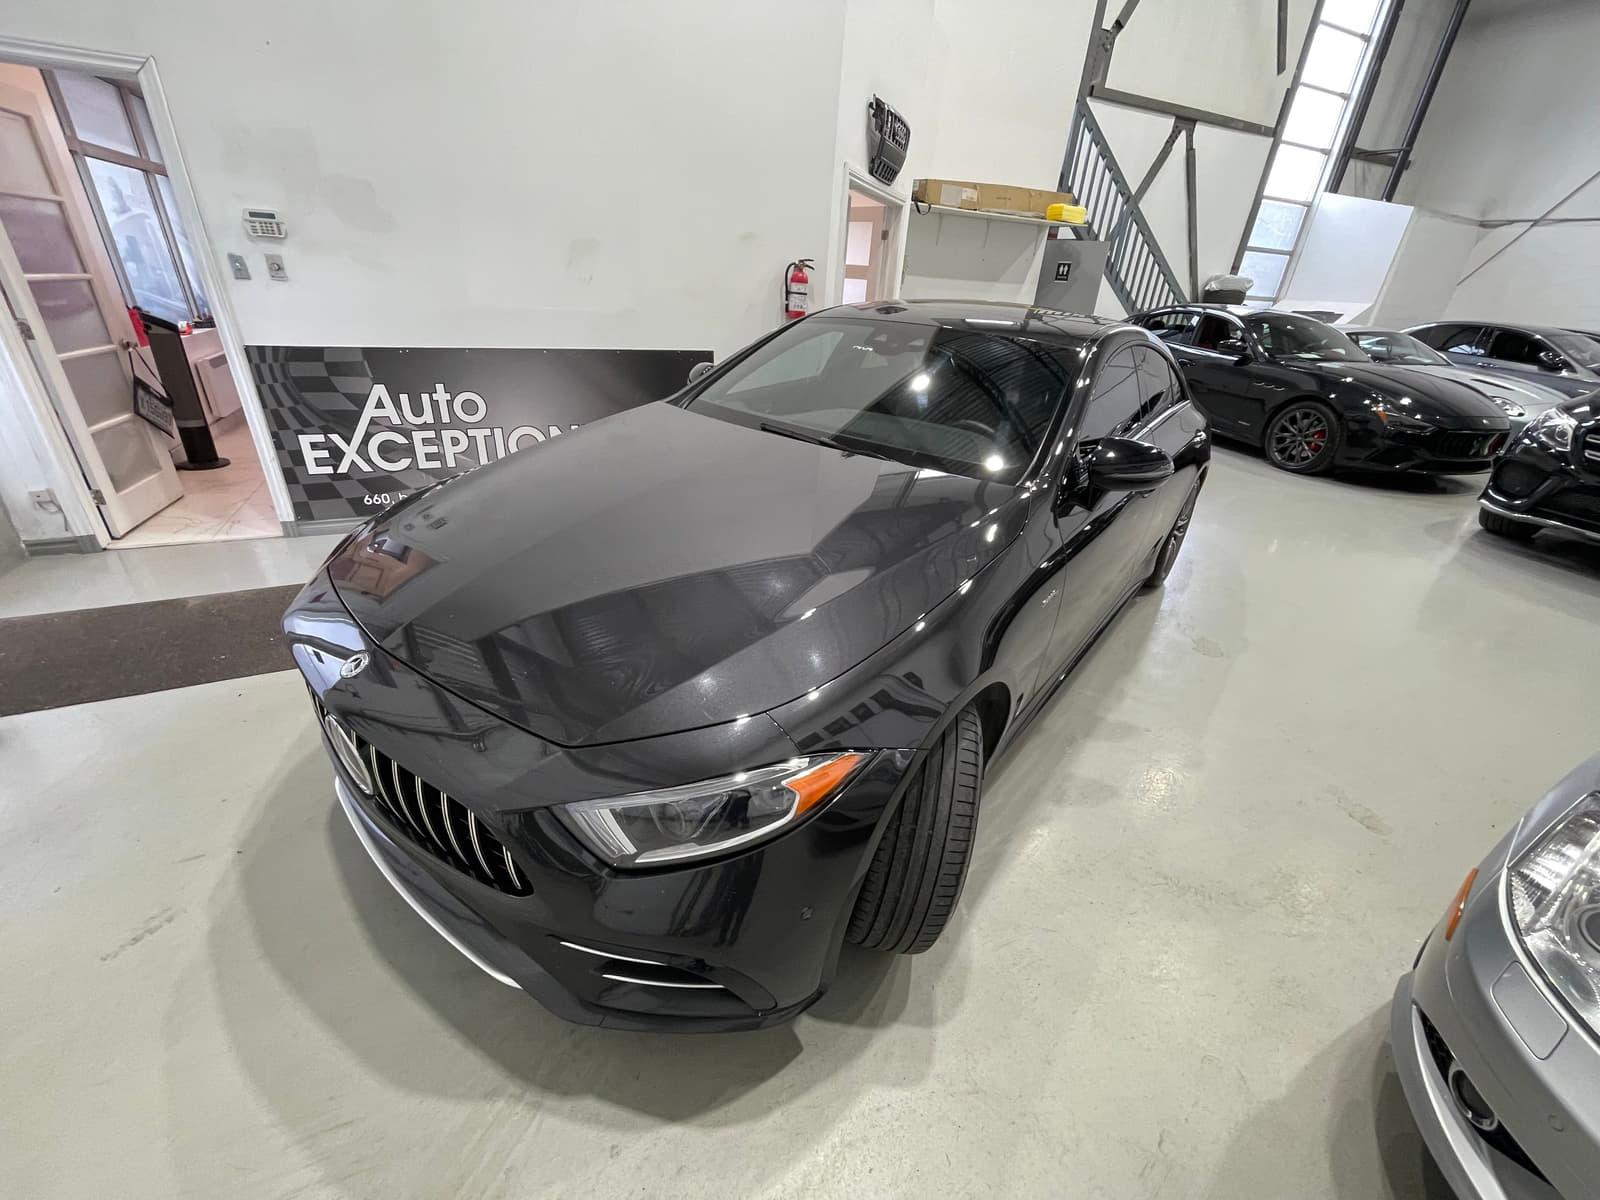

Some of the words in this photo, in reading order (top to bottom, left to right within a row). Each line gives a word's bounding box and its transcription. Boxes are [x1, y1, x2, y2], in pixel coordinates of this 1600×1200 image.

[359, 383, 488, 426] Auto
[297, 424, 580, 475] EXCEPTIO
[363, 493, 395, 505] 660,
